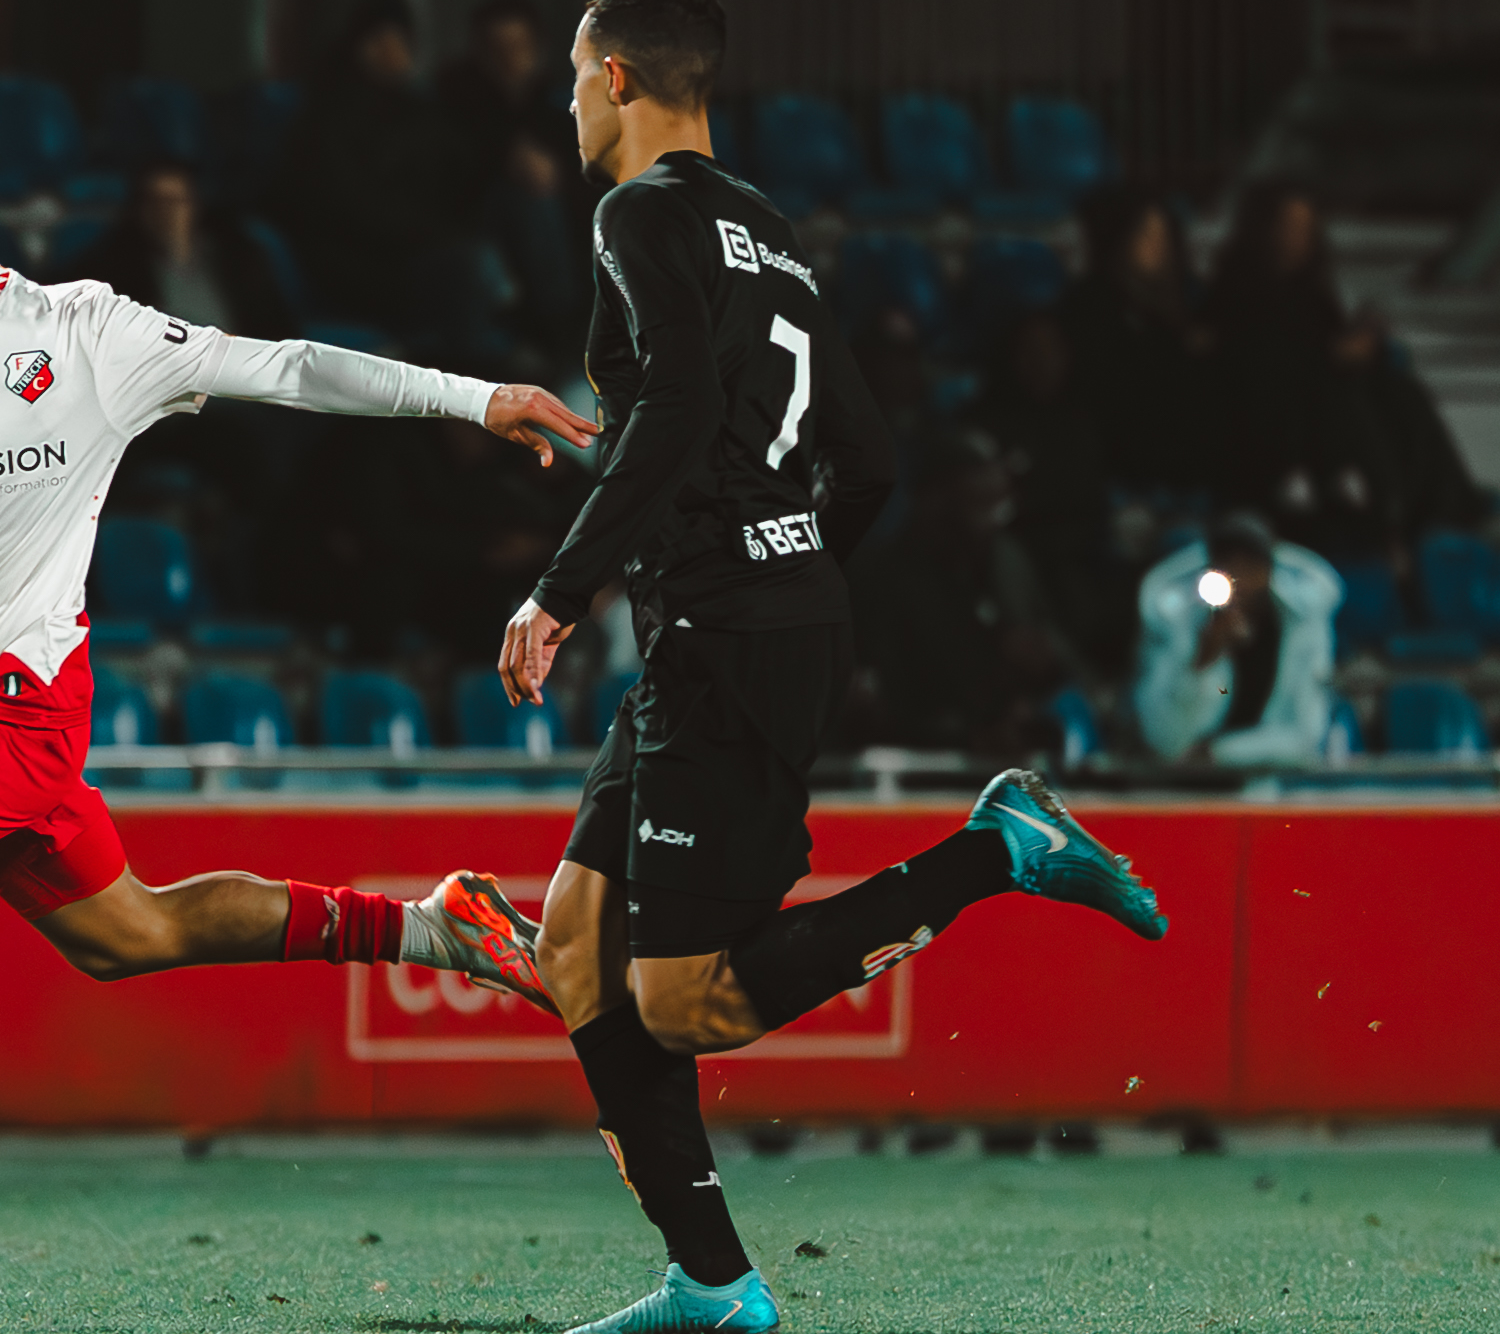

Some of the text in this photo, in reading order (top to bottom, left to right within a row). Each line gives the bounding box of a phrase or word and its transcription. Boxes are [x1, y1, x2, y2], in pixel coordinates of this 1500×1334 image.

[12, 353, 49, 395] UTRECHT
[15, 357, 24, 370] F
[32, 376, 45, 391] C
[766, 313, 811, 471] 7
